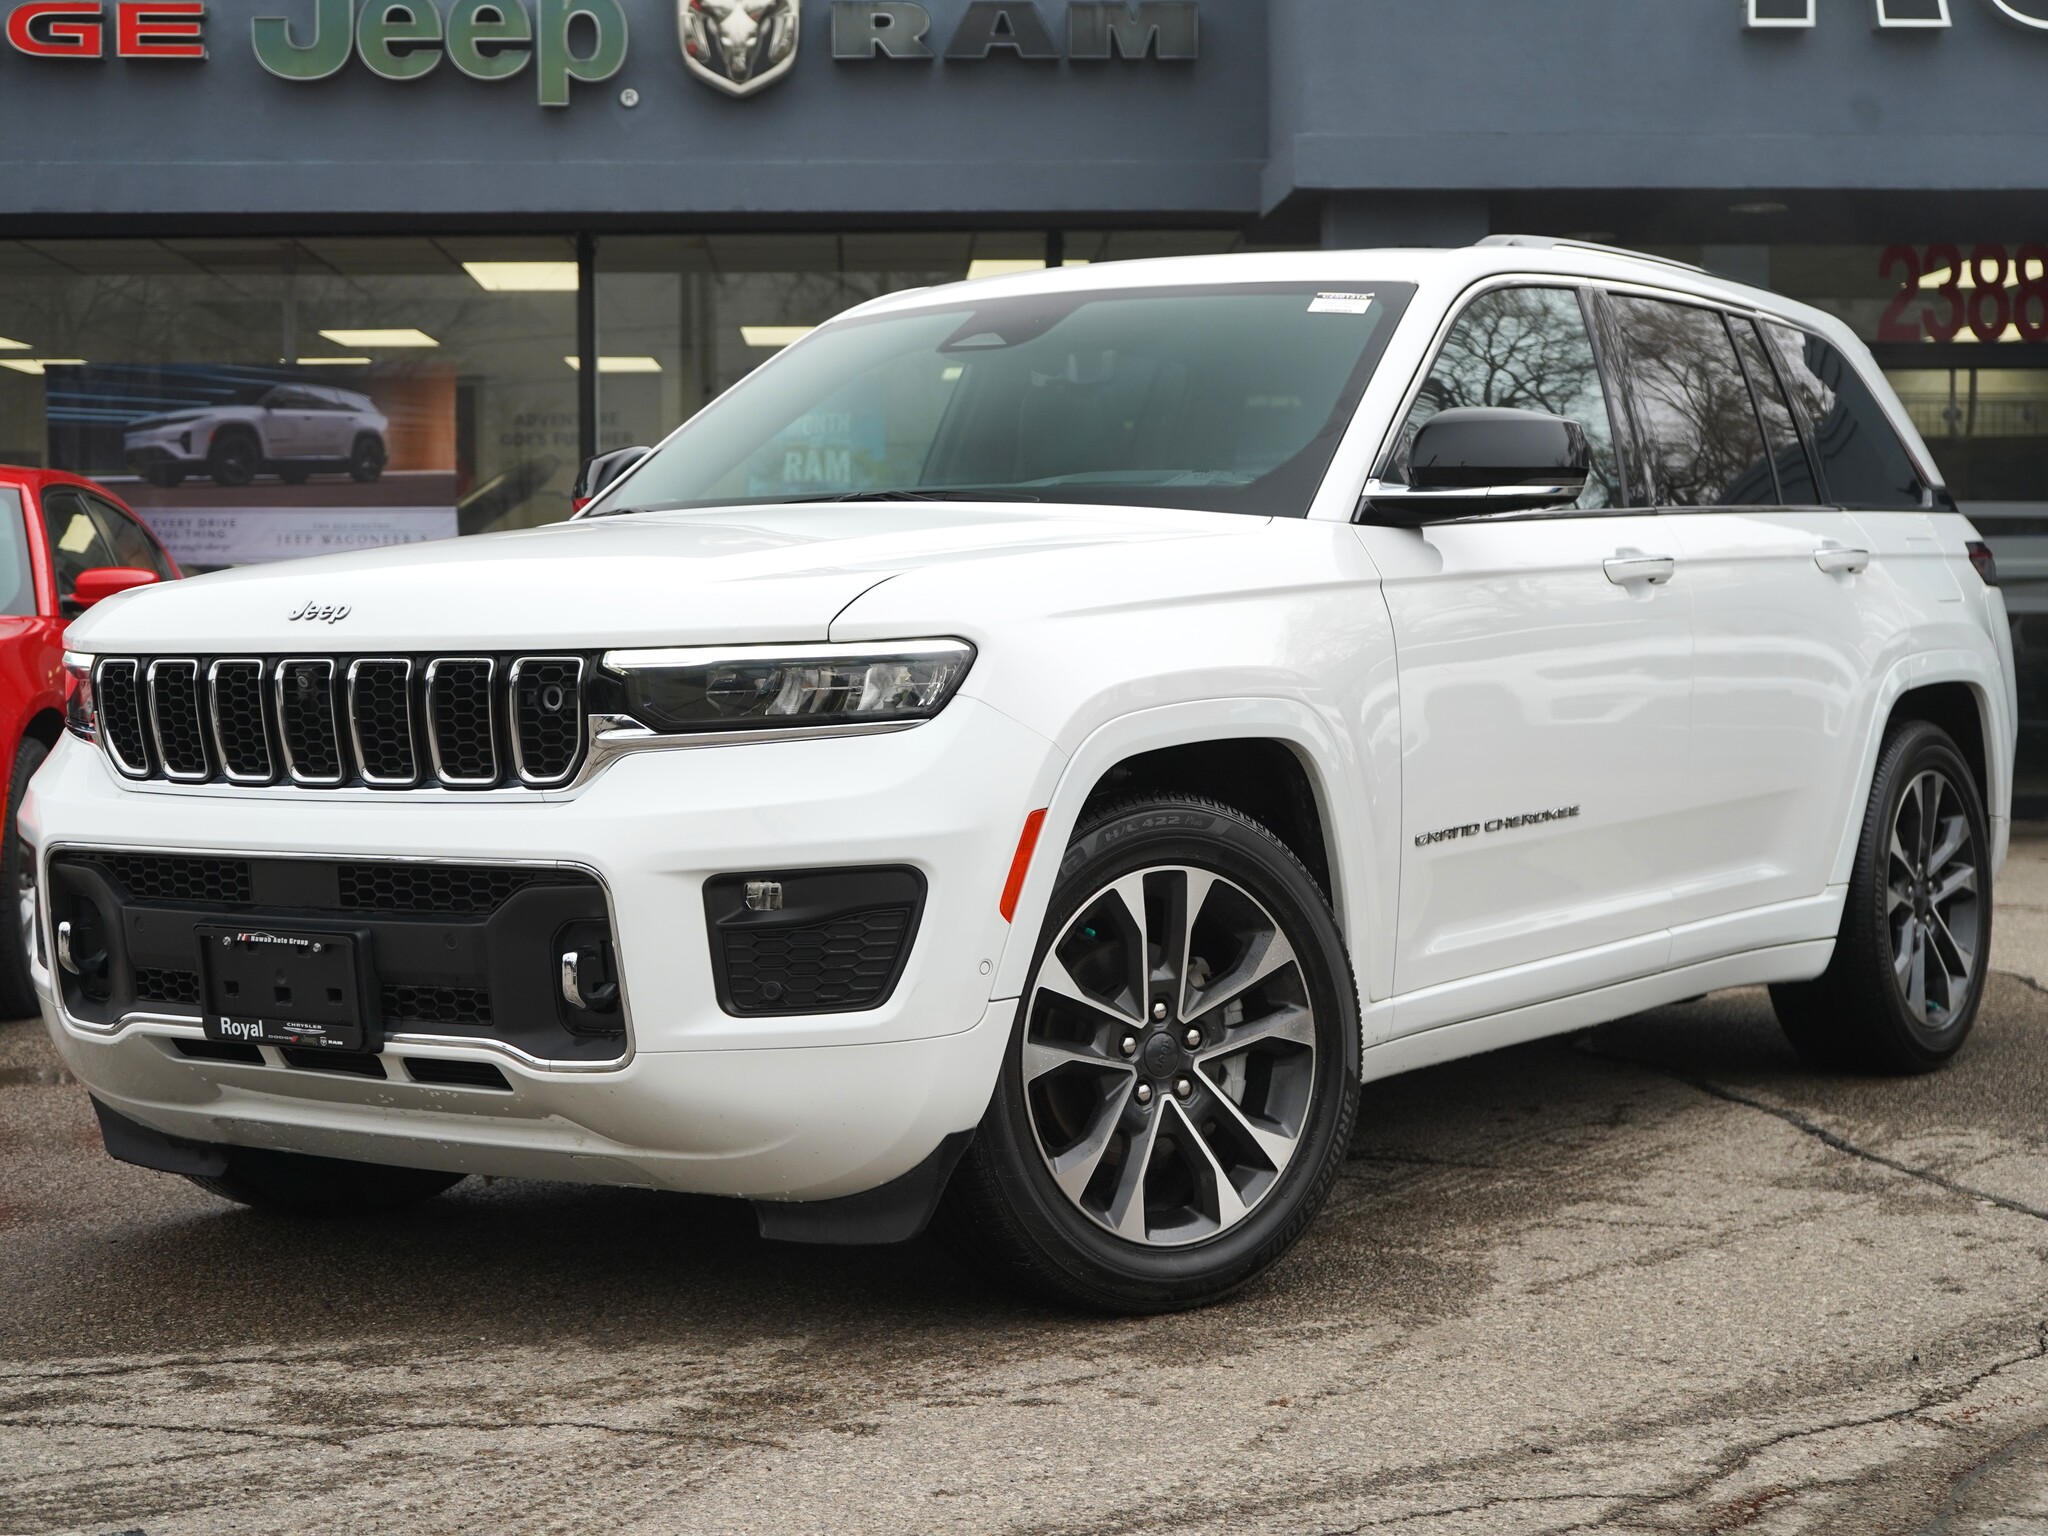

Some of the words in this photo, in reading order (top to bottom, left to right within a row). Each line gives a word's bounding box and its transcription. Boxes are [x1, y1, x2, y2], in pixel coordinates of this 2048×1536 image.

[830, 0, 1199, 60] RAM
[251, 0, 629, 106] Jeep
[783, 449, 851, 484] RAM
[151, 517, 193, 528] EVERY
[198, 517, 238, 529] DRIVE
[275, 533, 313, 546] JEEP
[287, 599, 352, 625] Jeep
[1142, 815, 1181, 828] 422
[1414, 822, 1481, 847] GRAND
[1484, 803, 1582, 834] CHEROKEE
[288, 937, 309, 946] Group
[220, 1016, 264, 1041] Royal
[286, 1021, 322, 1030] CHRYSLER
